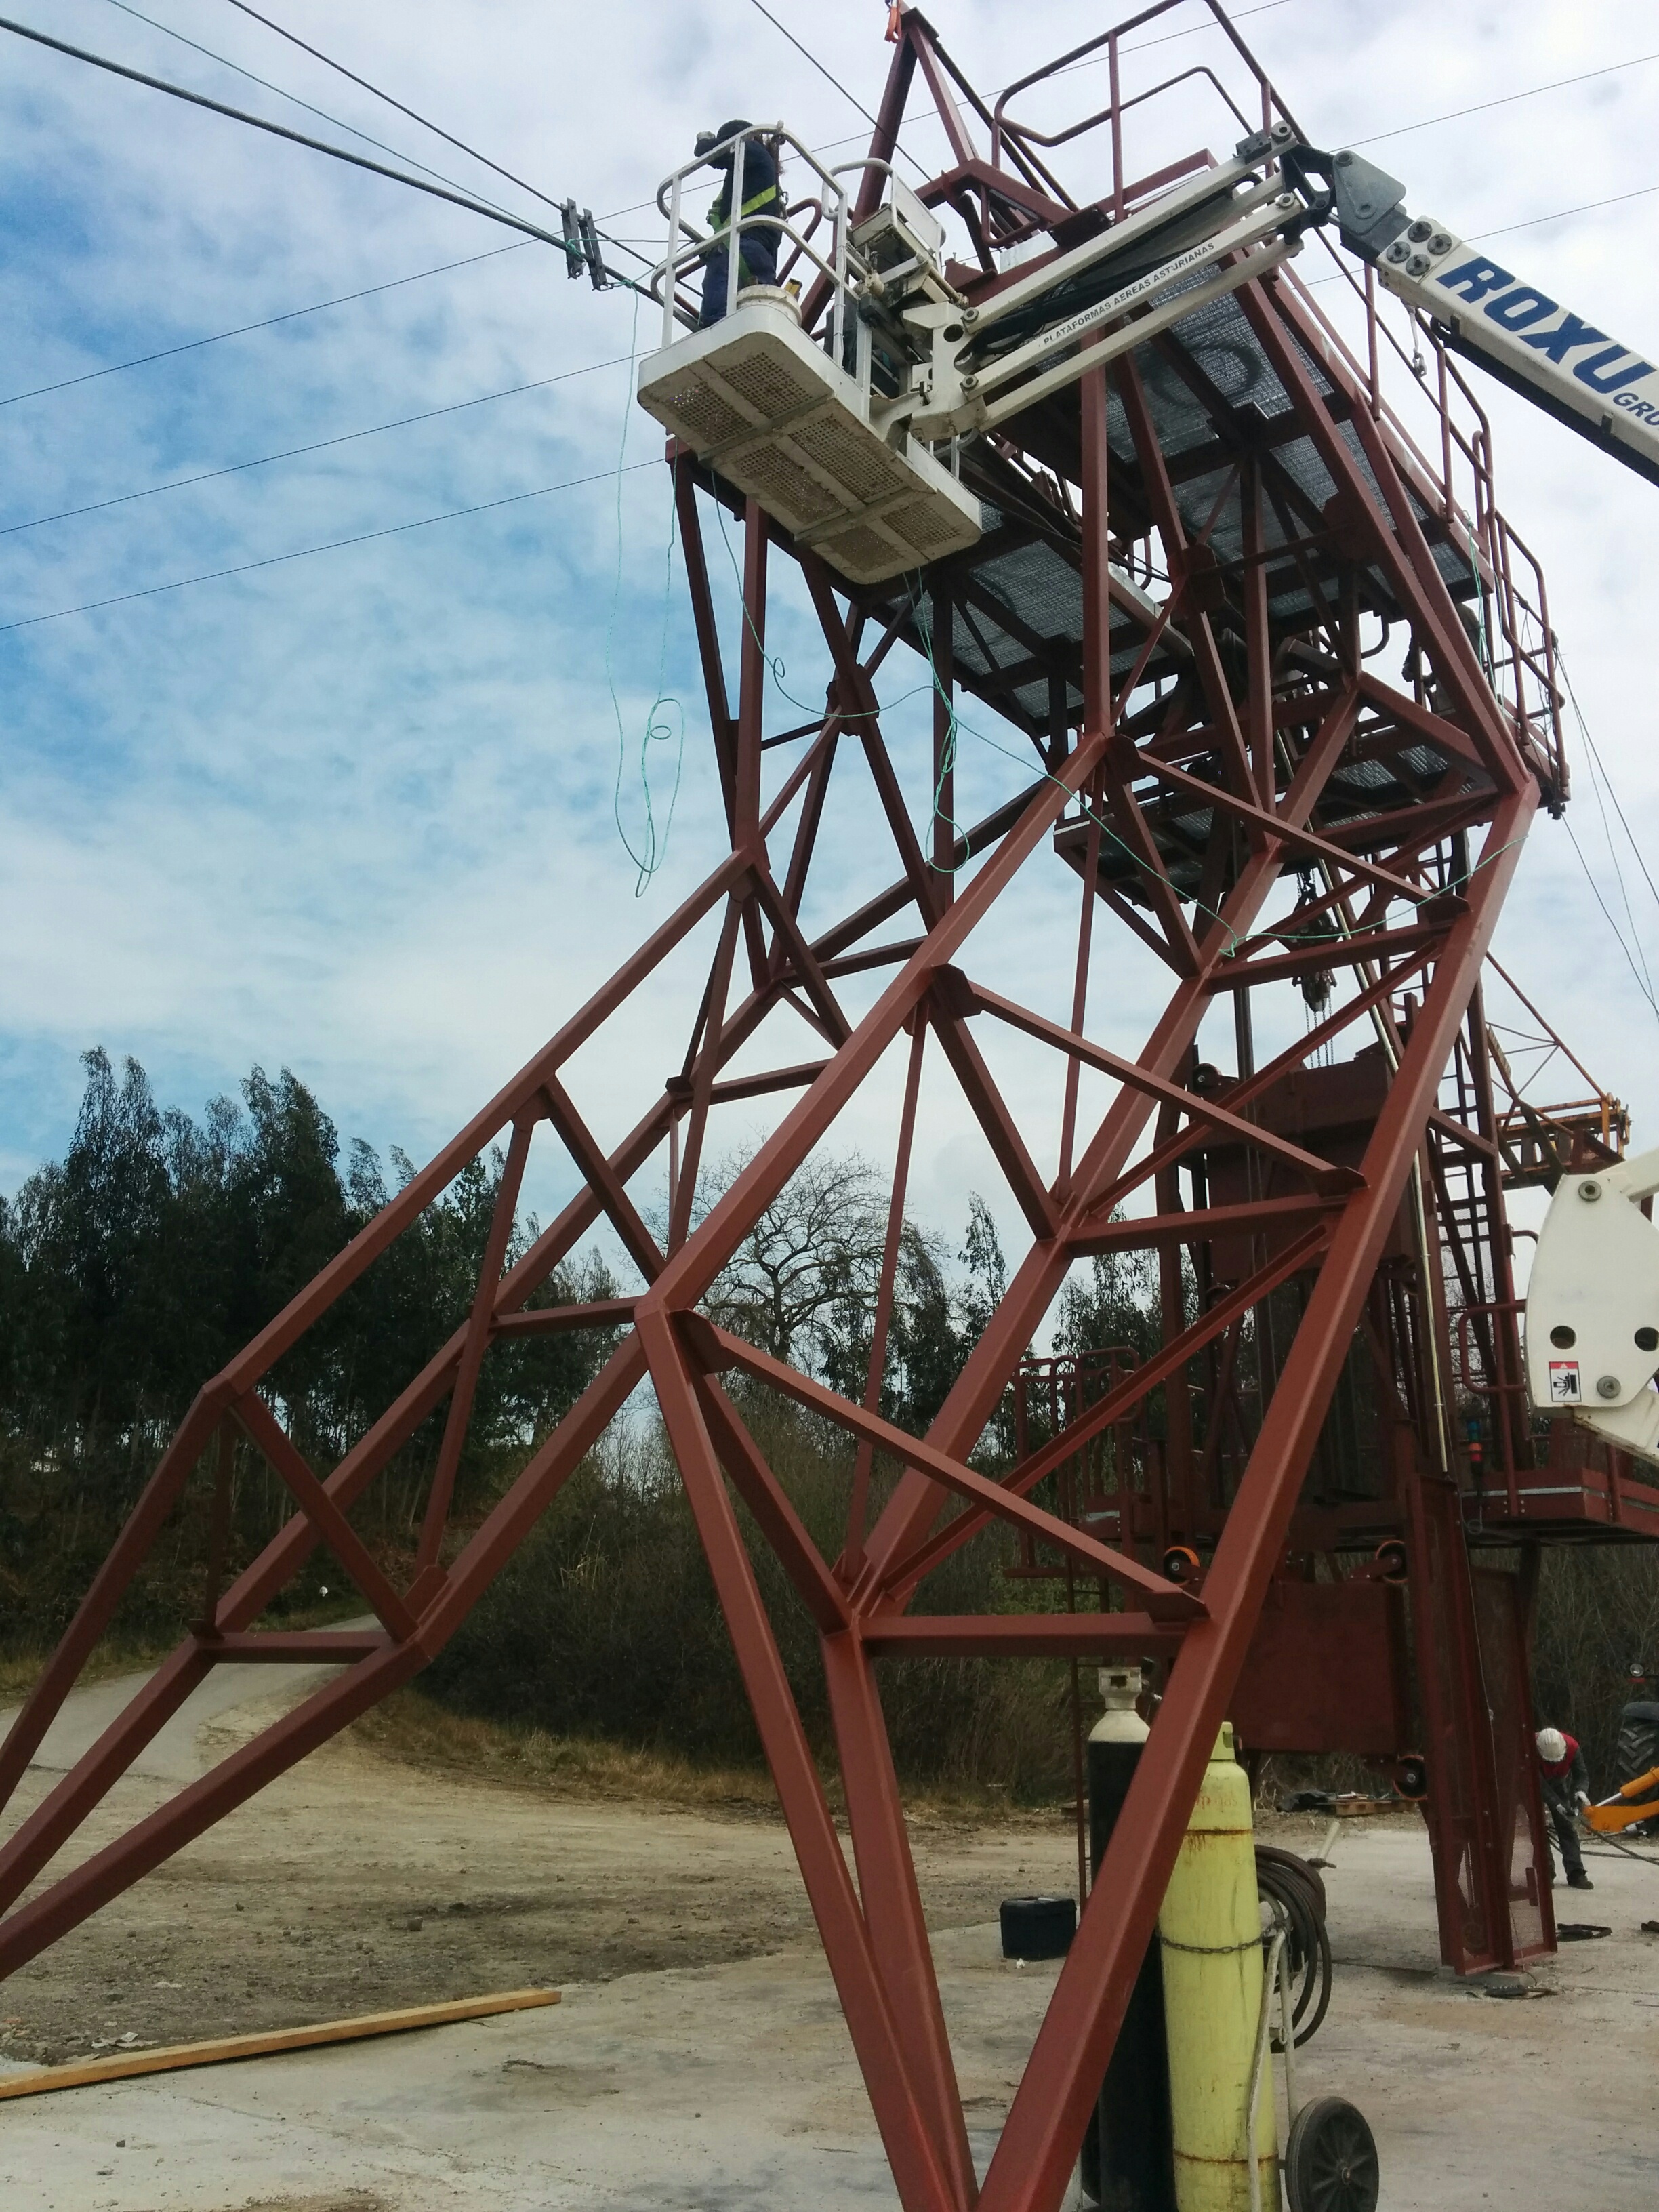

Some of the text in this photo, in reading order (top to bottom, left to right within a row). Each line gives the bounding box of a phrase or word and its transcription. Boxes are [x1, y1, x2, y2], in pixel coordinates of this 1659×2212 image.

[1044, 242, 1214, 344] PLATAFORMAS AEREAS ASTURIANAS
[1435, 255, 1658, 394] ROXU
